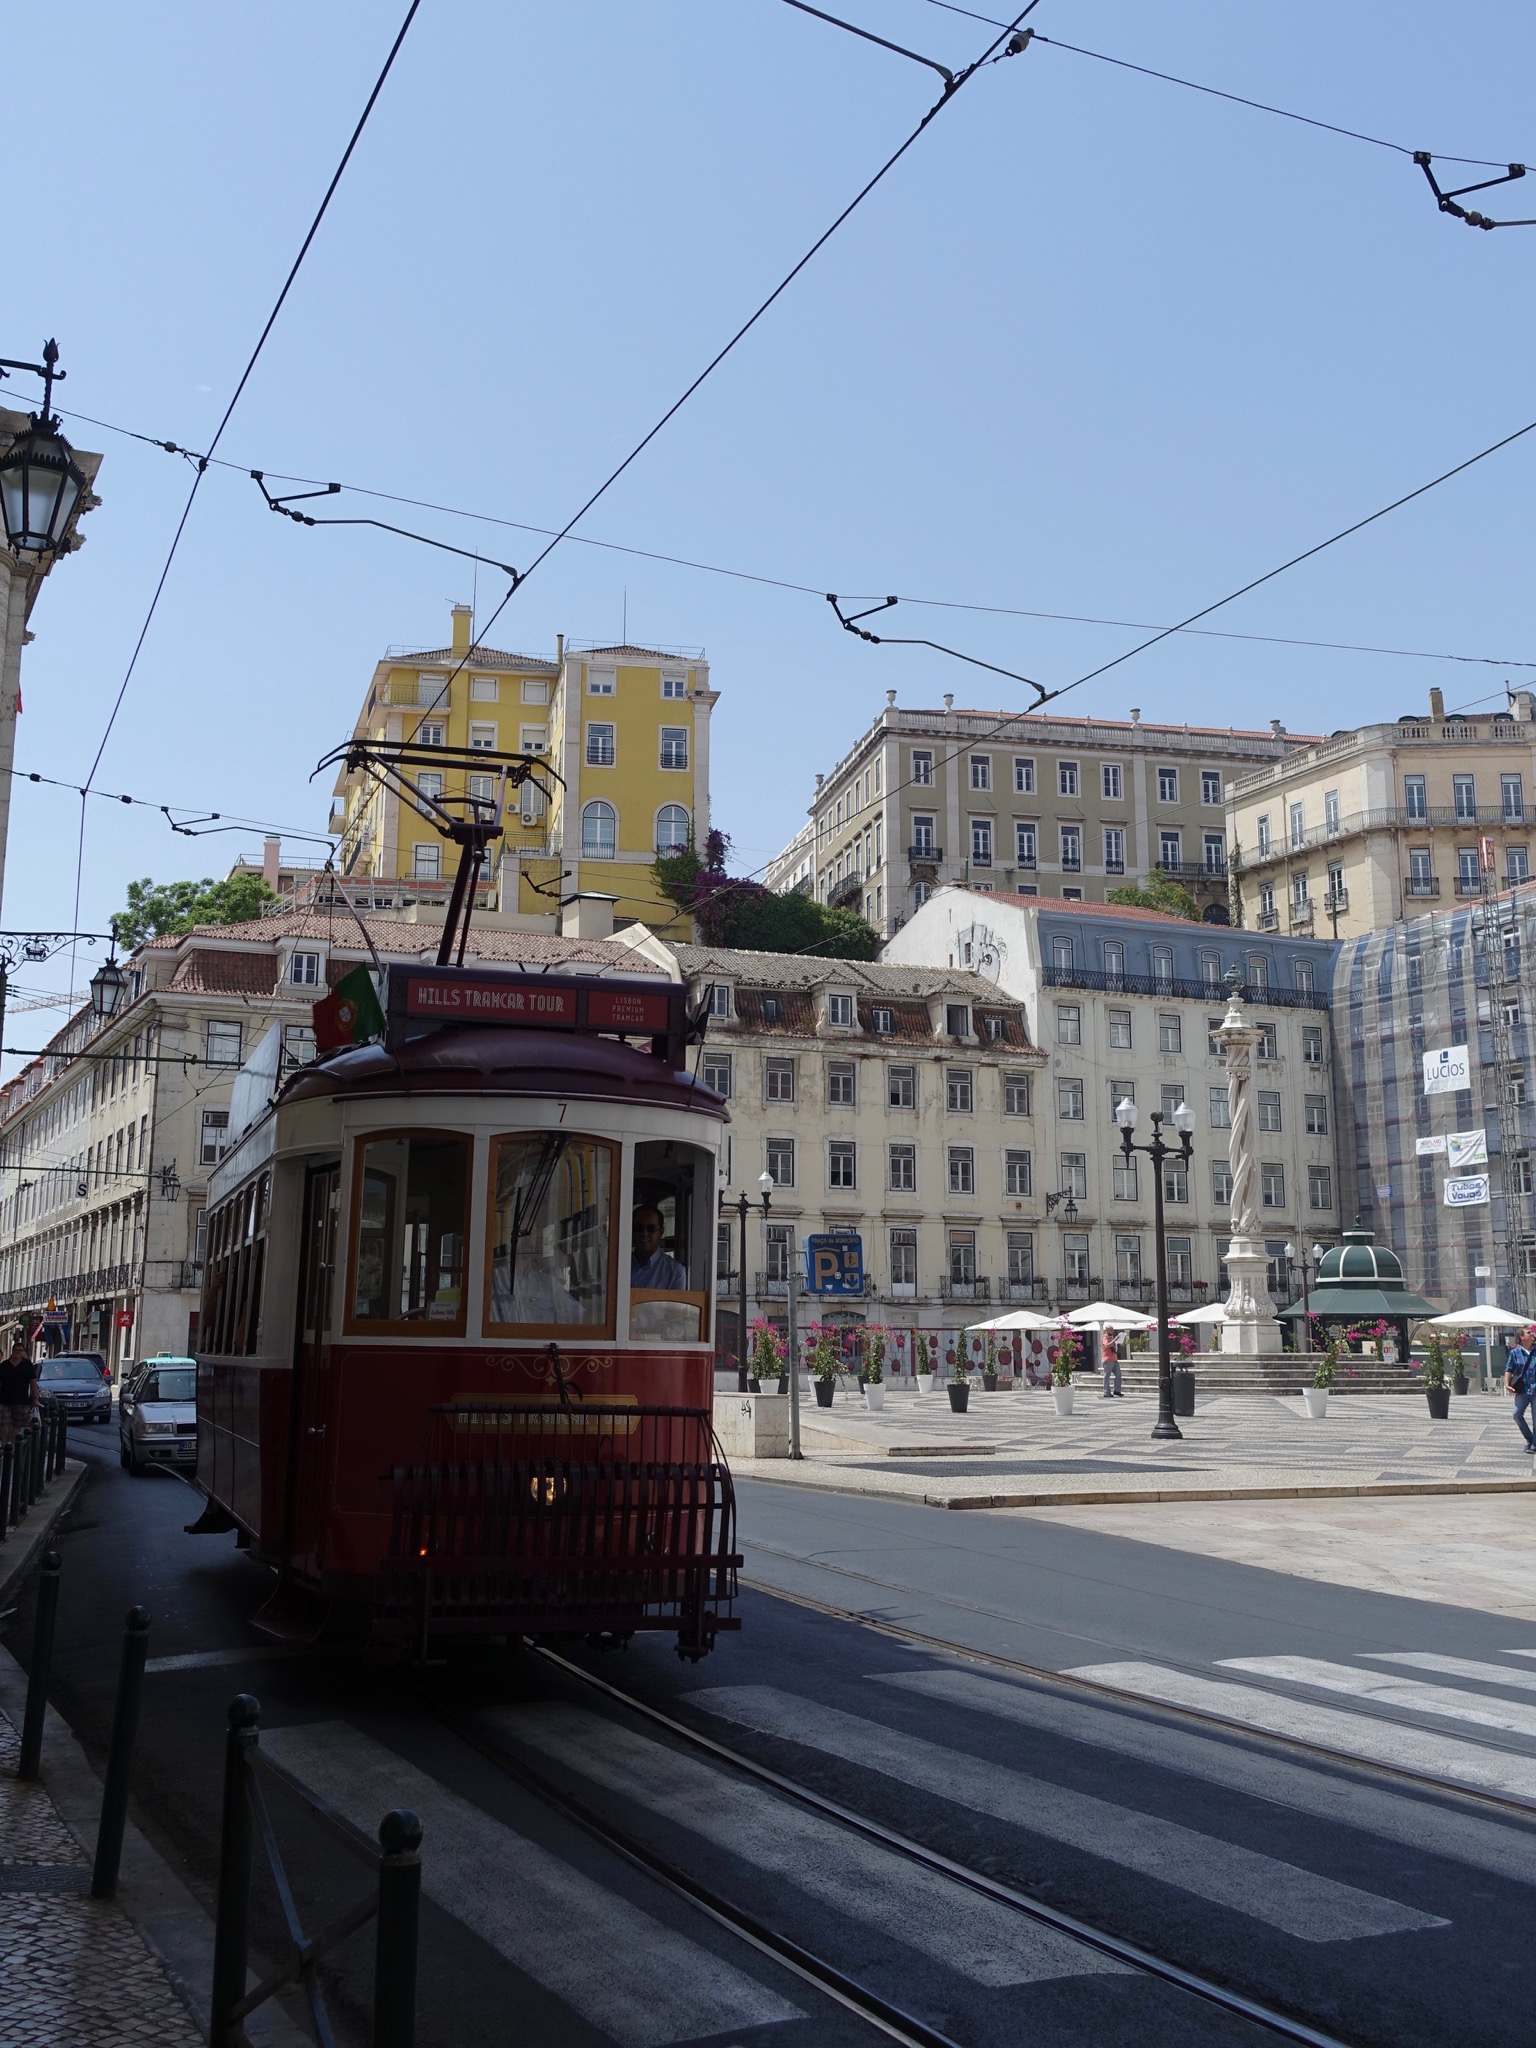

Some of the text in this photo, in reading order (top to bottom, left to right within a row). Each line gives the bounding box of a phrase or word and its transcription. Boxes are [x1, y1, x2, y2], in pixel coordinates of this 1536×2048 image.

[418, 987, 564, 1012] HILLS TRAMCAR TOUR
[612, 1004, 645, 1014] PREMIUM
[615, 996, 642, 1005] LISBON
[612, 1013, 644, 1022] TRAMCAR
[1427, 1062, 1465, 1081] LUCIOS
[557, 1103, 567, 1123] 7
[815, 1252, 838, 1289] P
